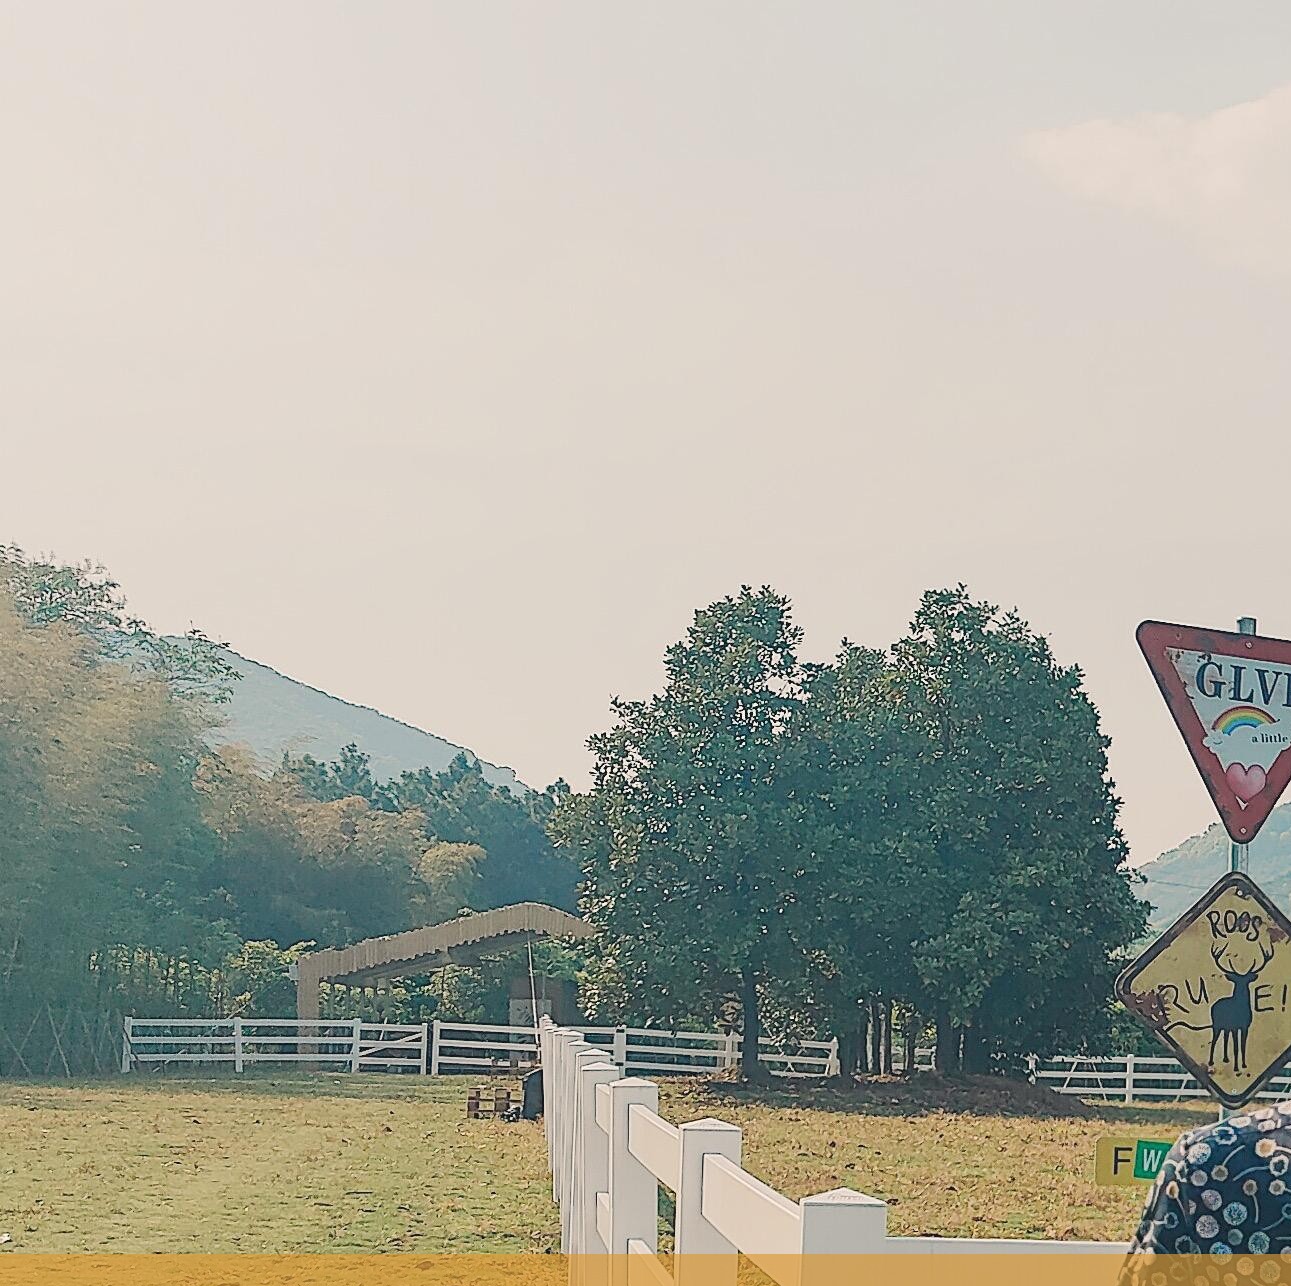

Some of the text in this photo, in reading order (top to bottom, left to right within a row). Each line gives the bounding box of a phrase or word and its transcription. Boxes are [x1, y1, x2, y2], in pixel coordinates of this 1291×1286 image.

[1251, 733, 1289, 744] a little
[1205, 909, 1263, 942] ROOS
